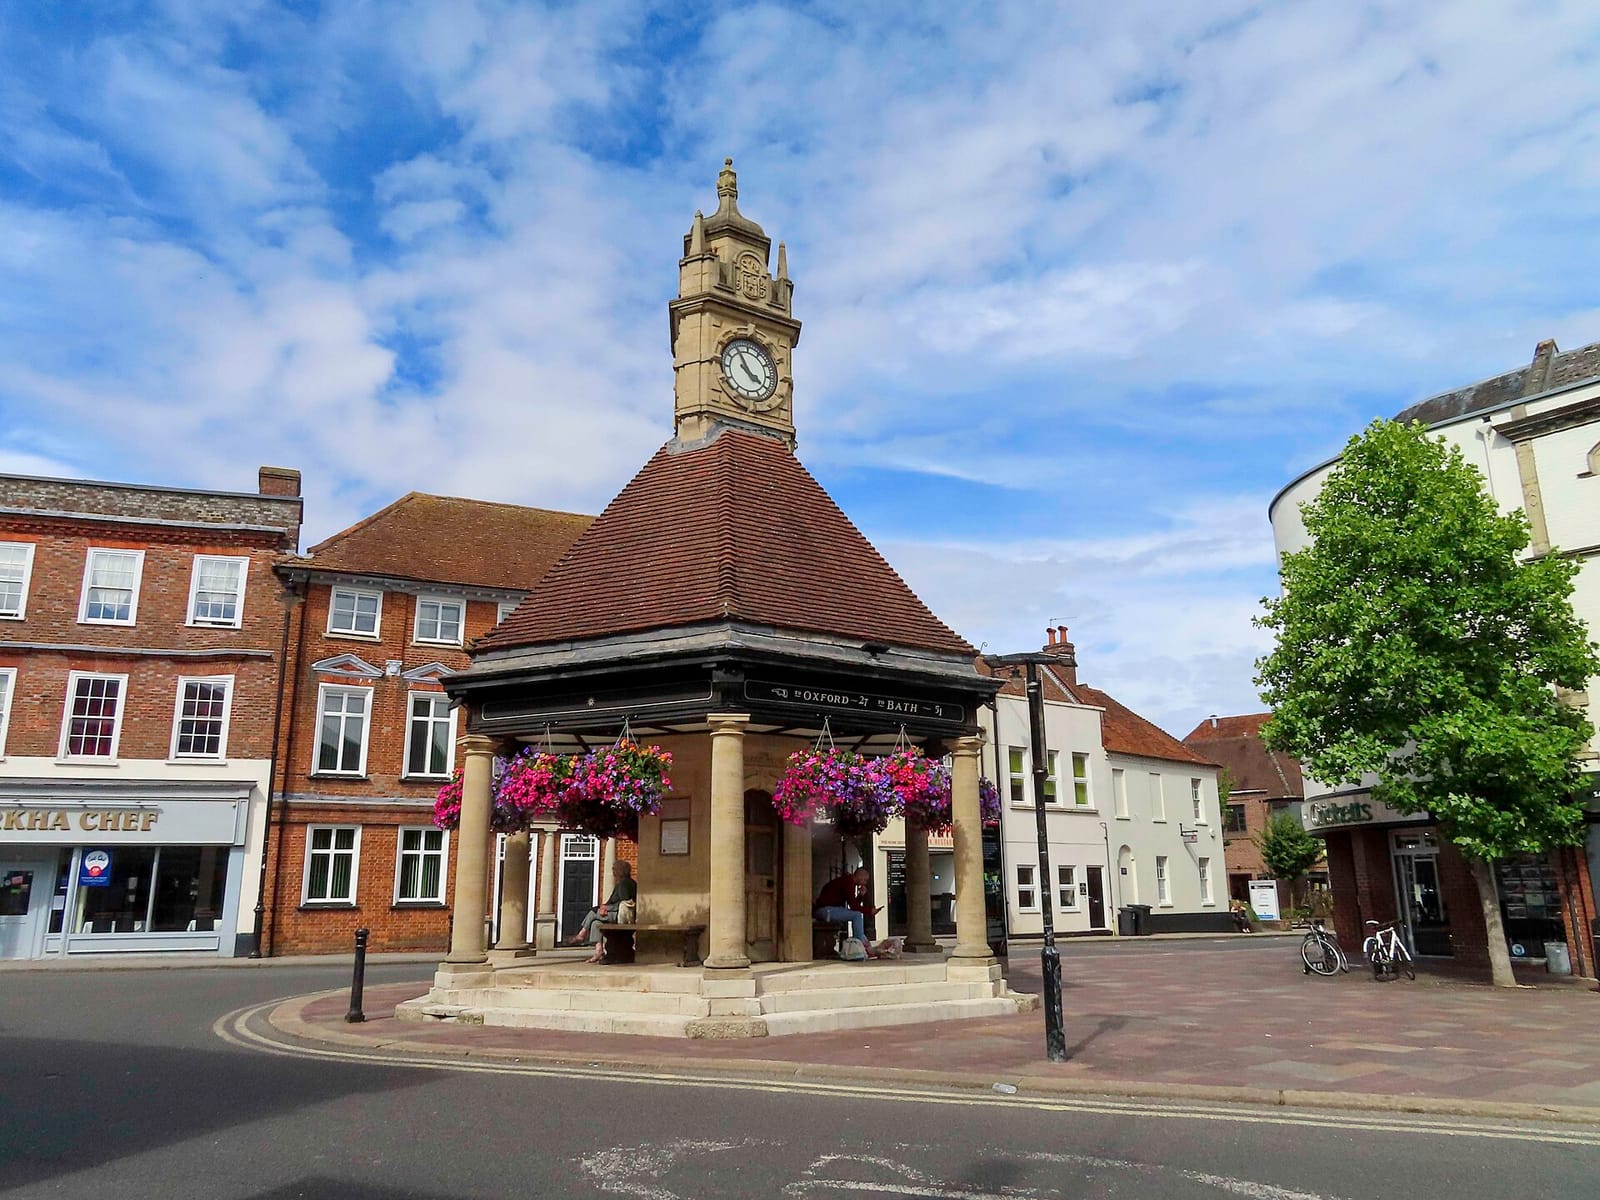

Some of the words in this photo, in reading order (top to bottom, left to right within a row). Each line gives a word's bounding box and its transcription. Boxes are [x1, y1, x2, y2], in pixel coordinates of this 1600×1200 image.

[803, 690, 850, 705] OXFORD
[886, 700, 918, 713] BATH
[0, 809, 71, 831] KHA
[79, 809, 158, 831] CHEF
